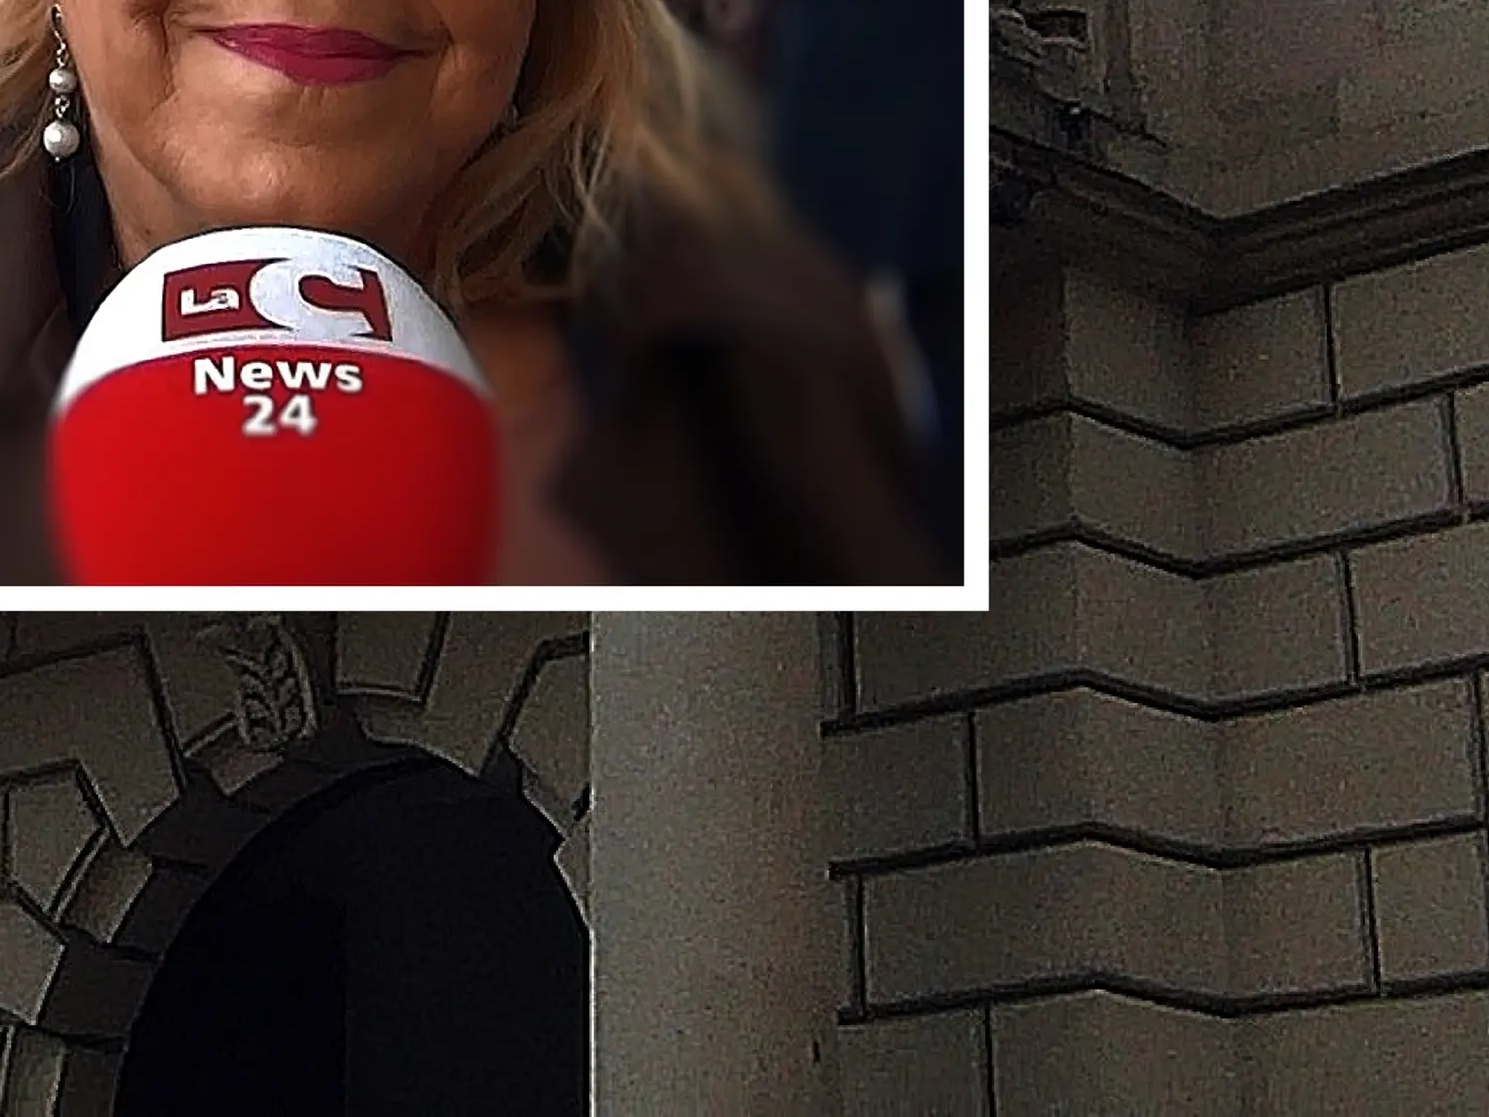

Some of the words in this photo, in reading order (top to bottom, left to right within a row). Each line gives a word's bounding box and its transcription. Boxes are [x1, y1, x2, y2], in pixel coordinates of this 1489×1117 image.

[180, 287, 240, 316] La
[193, 355, 364, 395] News
[241, 395, 318, 436] 24
